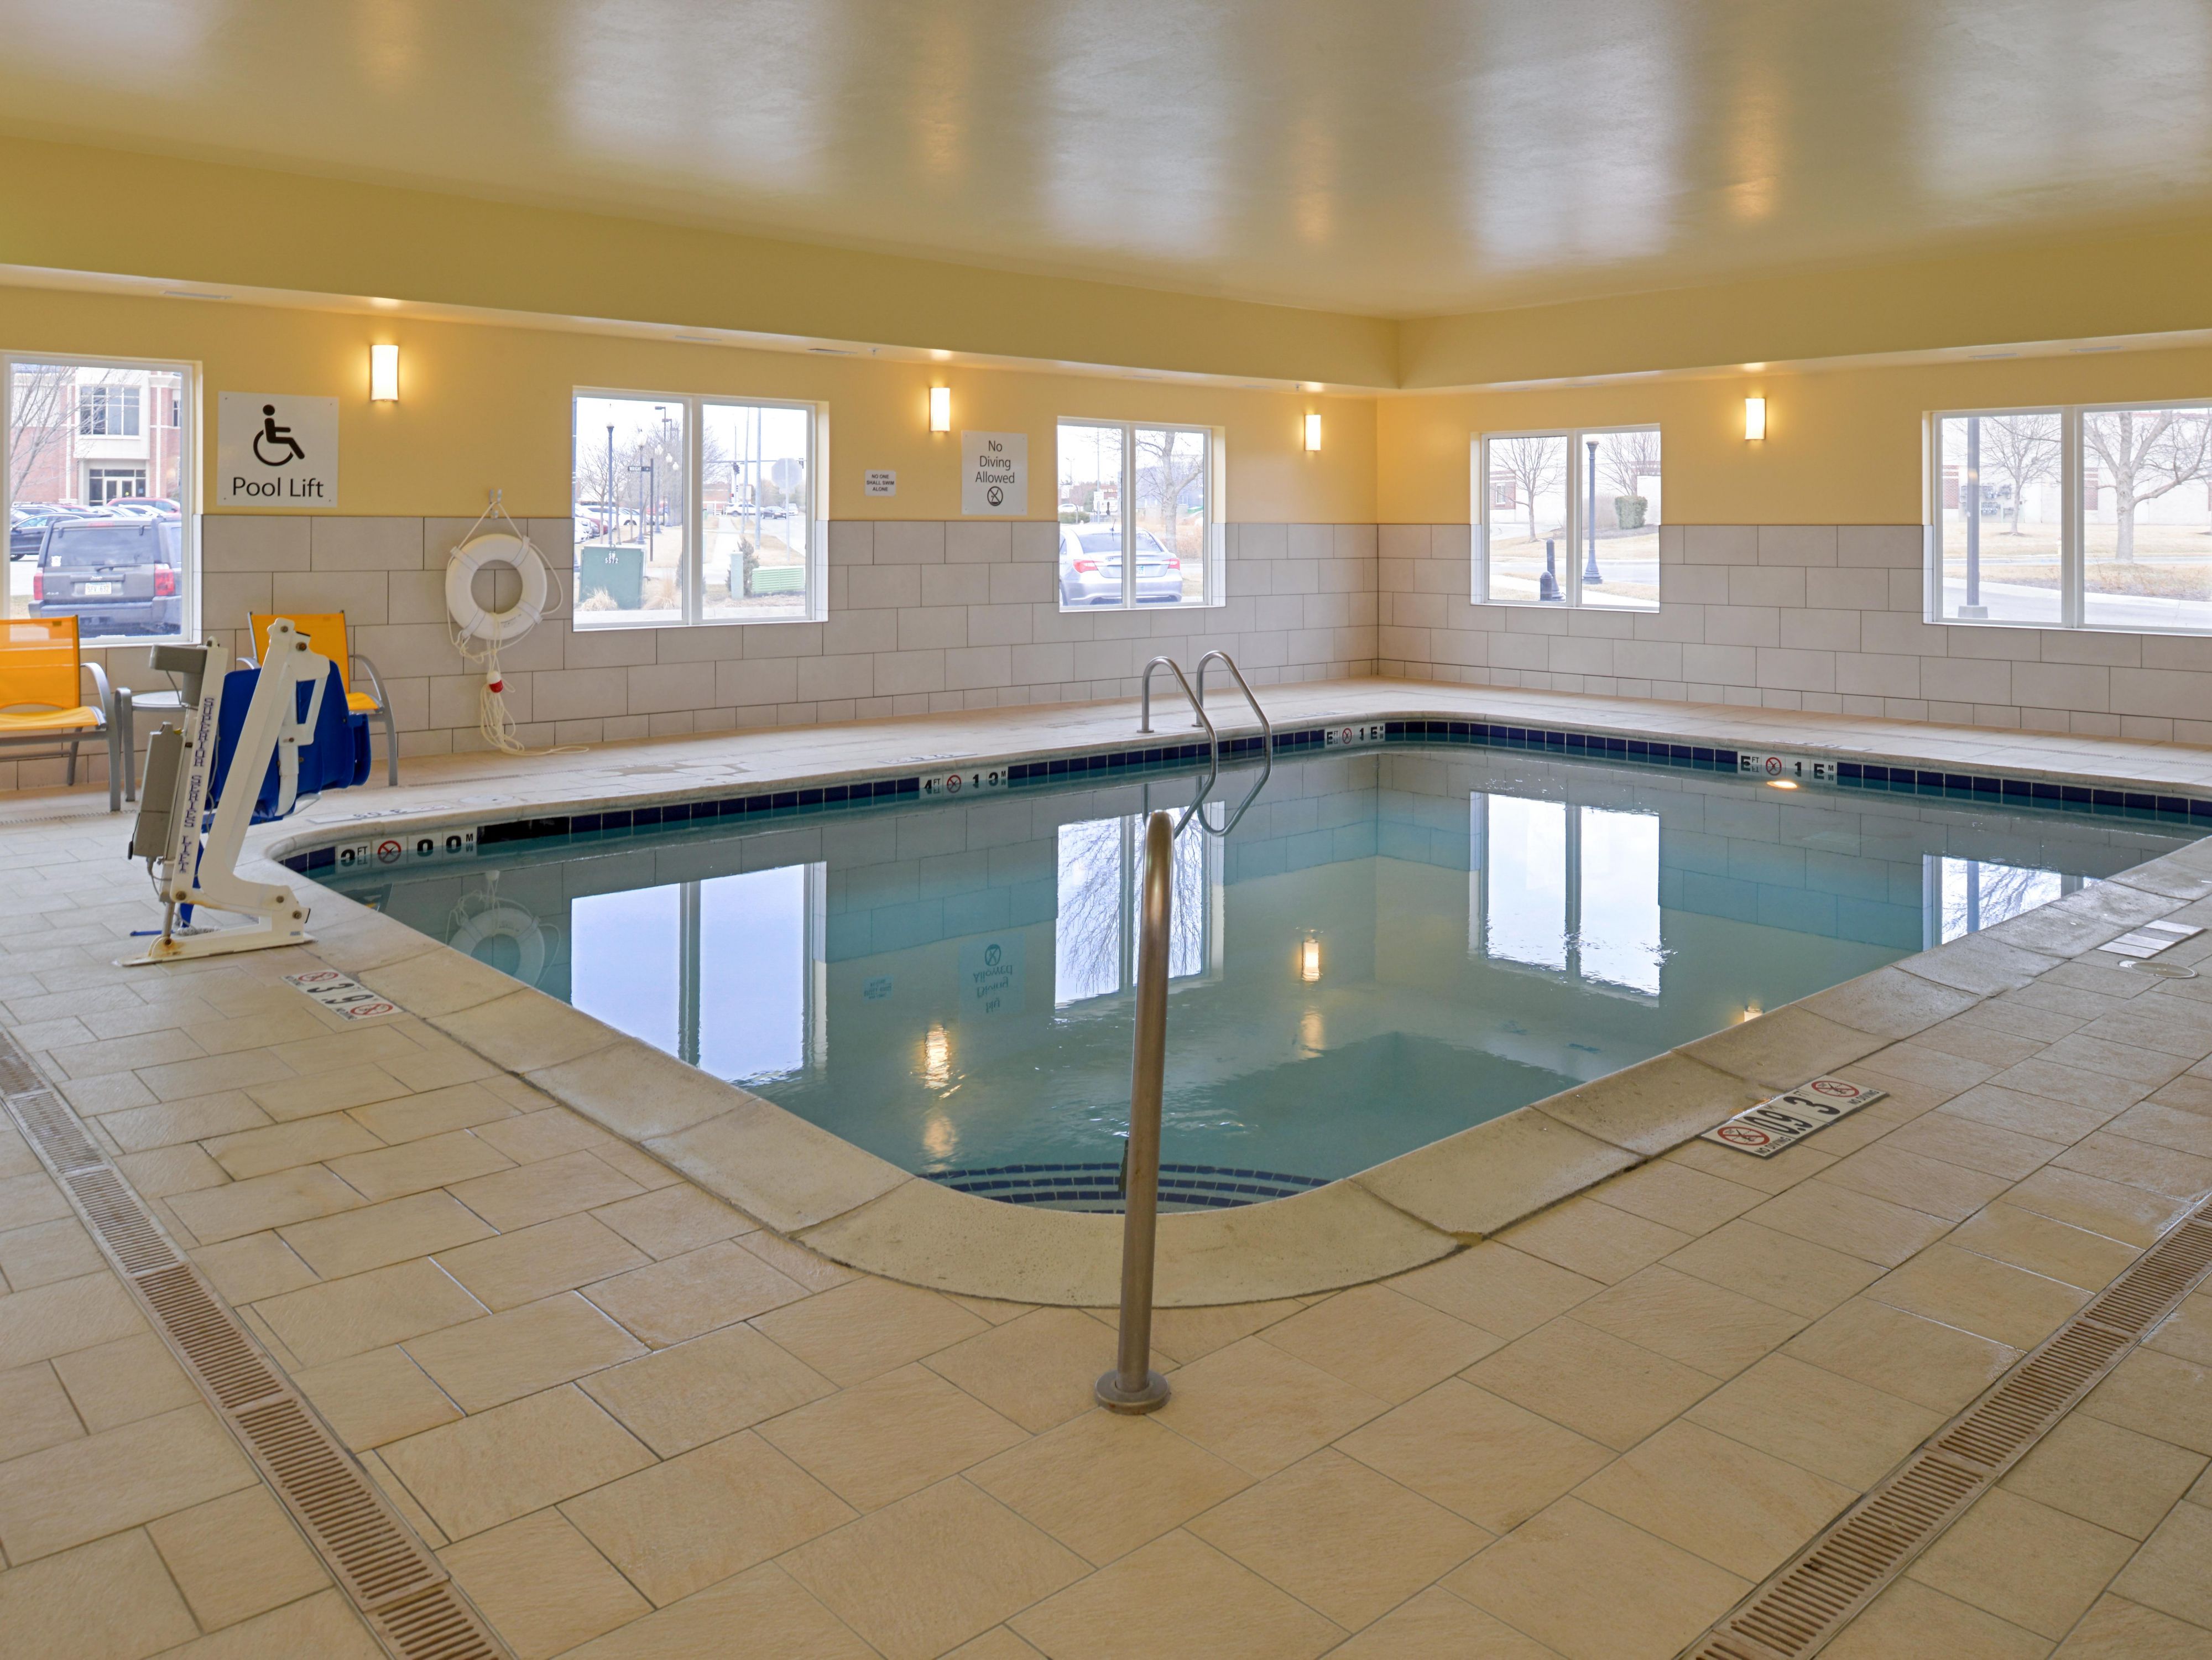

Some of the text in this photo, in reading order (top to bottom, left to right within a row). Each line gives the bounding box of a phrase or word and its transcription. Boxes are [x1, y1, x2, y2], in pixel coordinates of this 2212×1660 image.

[988, 440, 1003, 452] No
[979, 455, 1011, 471] Diving
[975, 471, 1015, 483] Allowed
[233, 477, 324, 497] Pool Lift
[184, 776, 202, 828] SERIES
[357, 846, 368, 856] FT
[466, 833, 473, 842] M
[307, 982, 354, 993] 3
[1859, 1089, 1880, 1101] DIVING
[1783, 1096, 1840, 1115] 3
[1743, 1109, 1813, 1135] 0.9
[1755, 1136, 1792, 1156] NO DIVING
